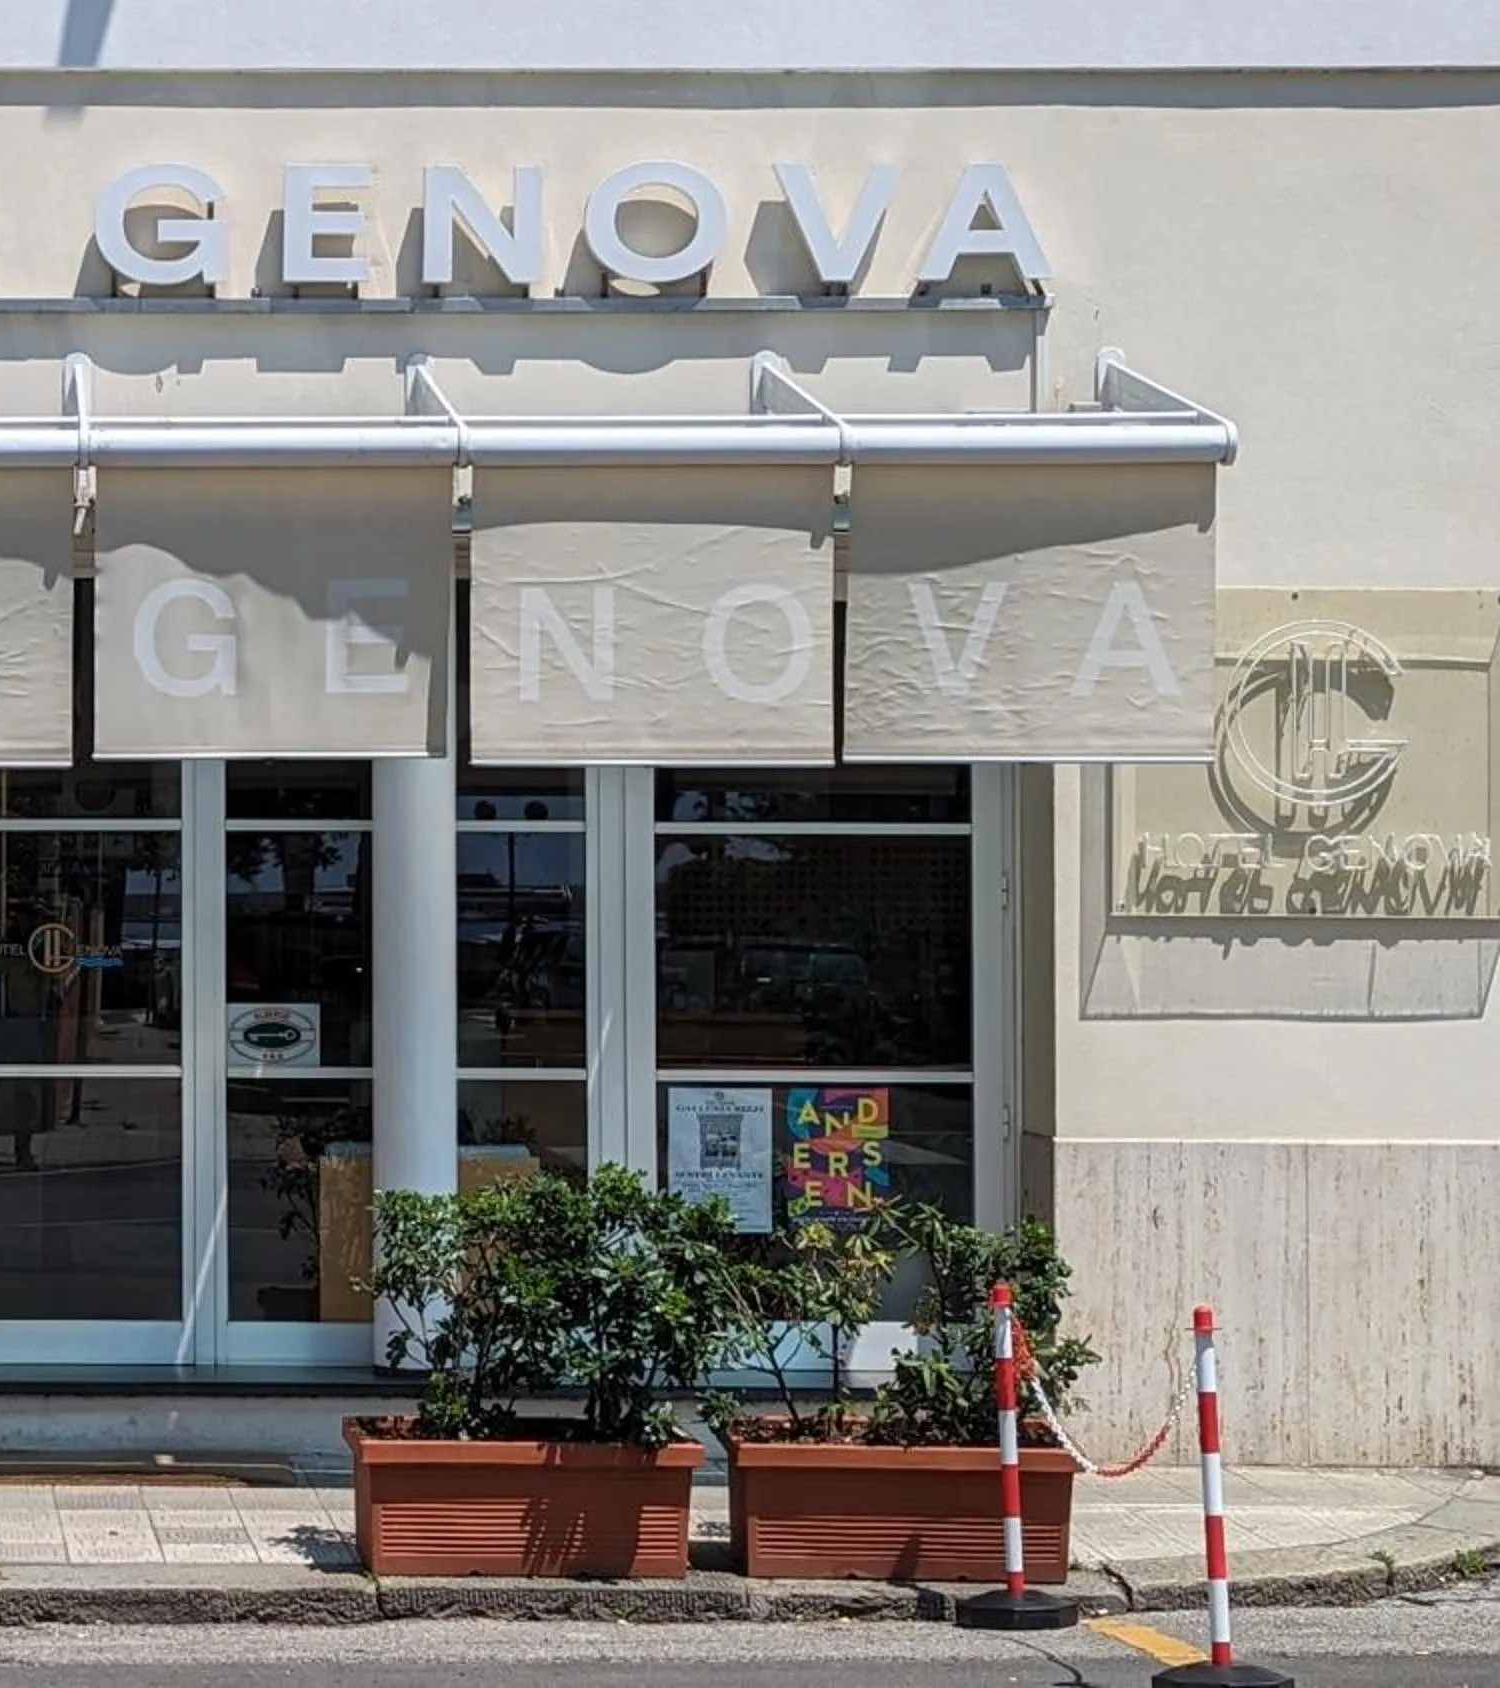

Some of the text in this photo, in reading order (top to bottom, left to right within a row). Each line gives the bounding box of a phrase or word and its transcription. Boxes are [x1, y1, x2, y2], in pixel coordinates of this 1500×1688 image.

[94, 160, 1052, 287] GENOVA
[132, 578, 1182, 703] GENOVA
[1141, 832, 1492, 872] HOTEL GENOVA
